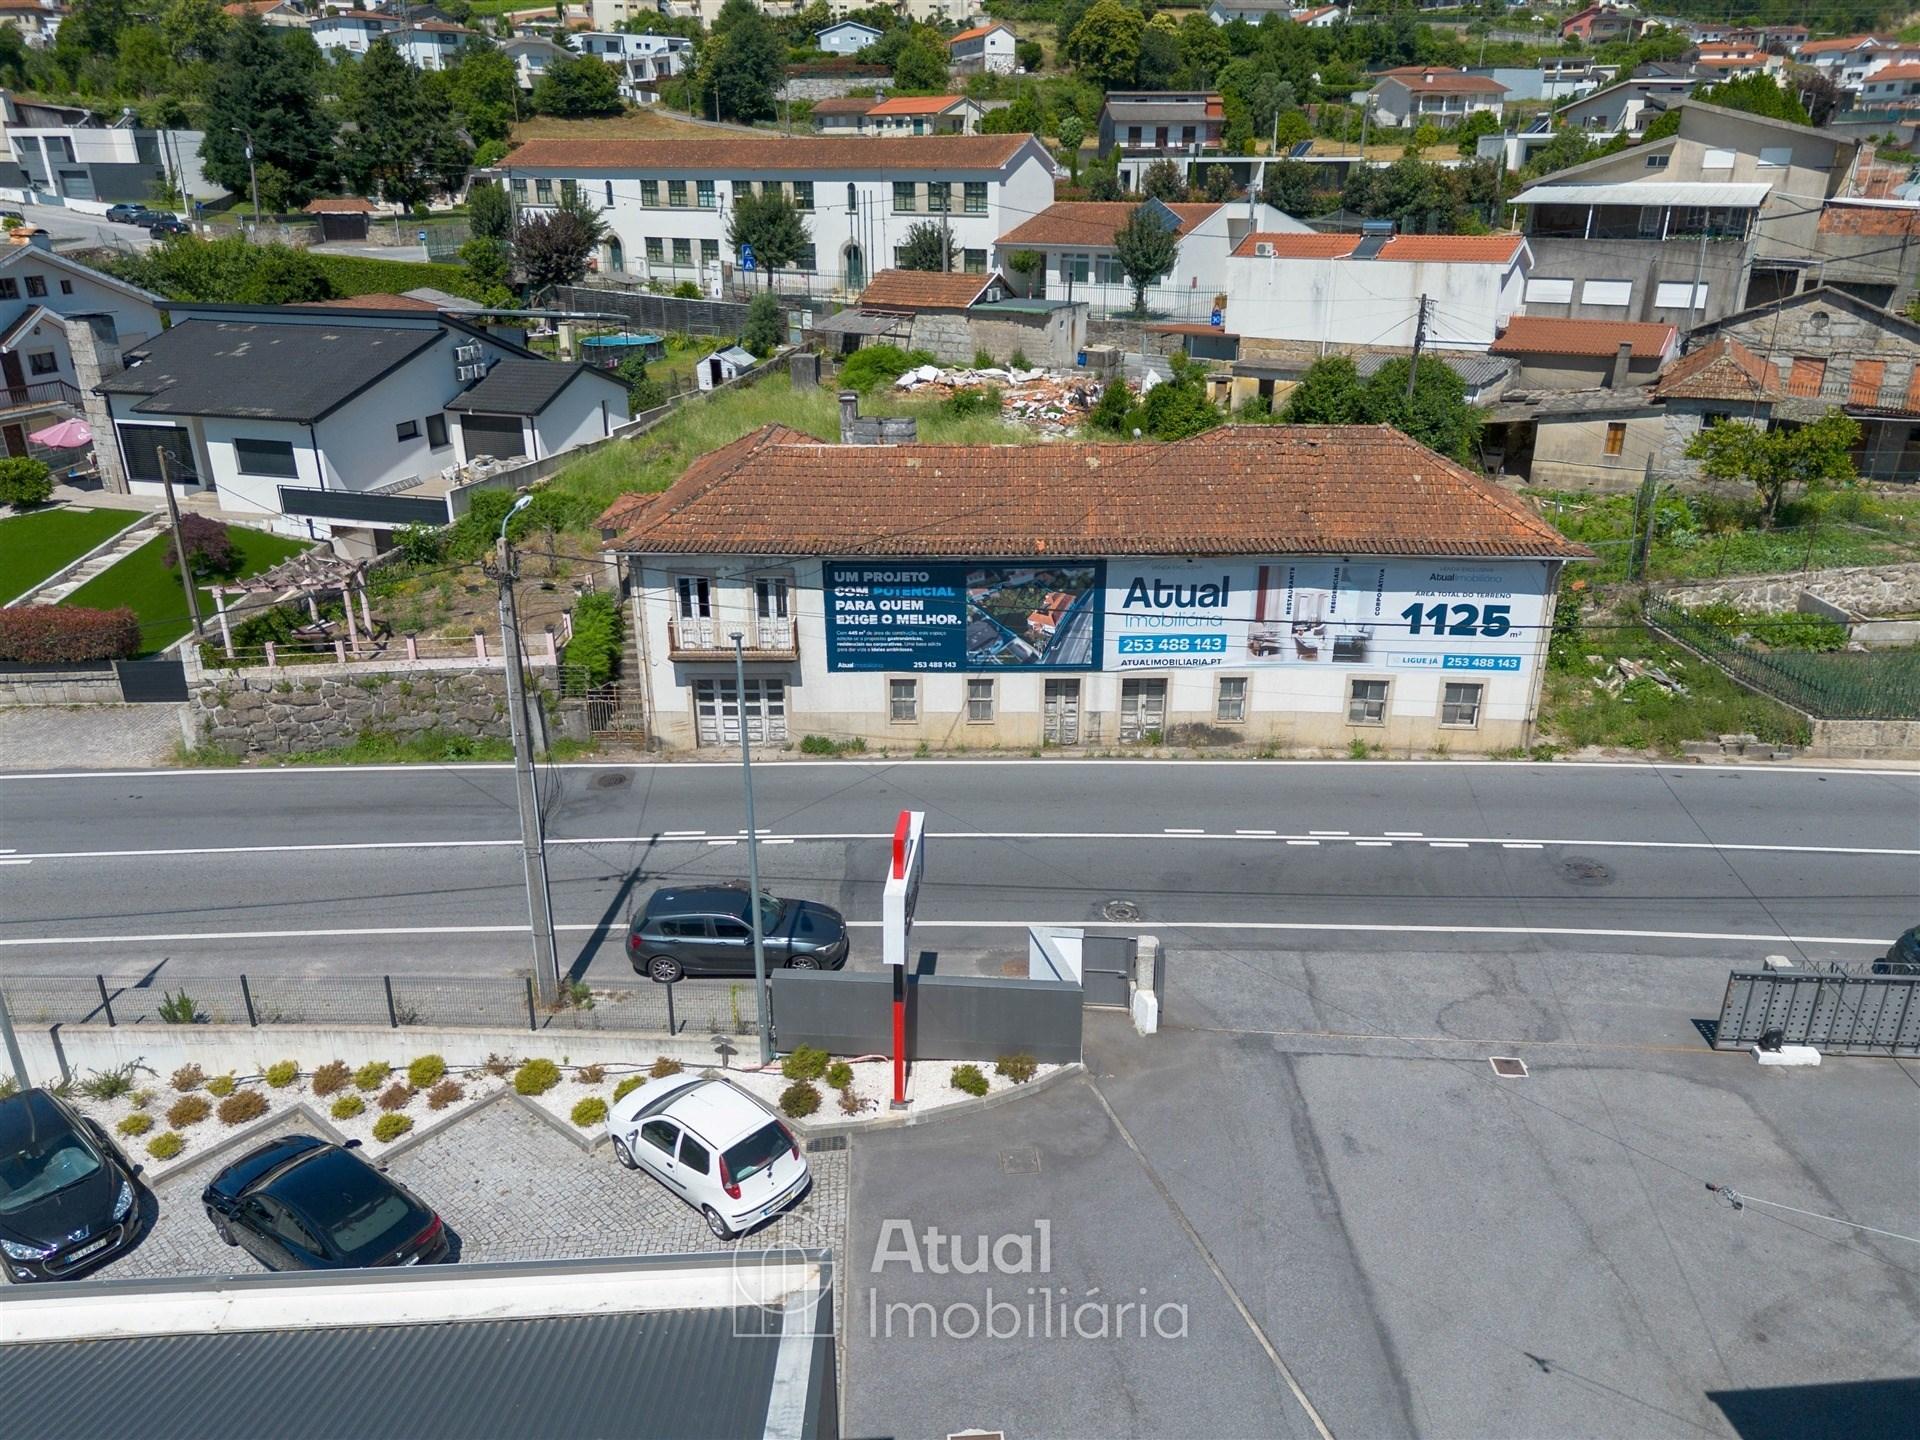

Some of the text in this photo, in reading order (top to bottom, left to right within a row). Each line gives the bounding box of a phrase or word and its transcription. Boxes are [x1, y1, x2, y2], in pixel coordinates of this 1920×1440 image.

[834, 571, 930, 583] UM PROJETO
[834, 586, 956, 597] COM POTENCIAL
[1122, 576, 1230, 609] Atual
[835, 600, 924, 611] PARA QUEM
[836, 614, 962, 625] EXIGE O MELHOR.
[1401, 602, 1511, 637] 1125
[1123, 638, 1221, 652] 253 488 143
[1121, 658, 1222, 667] ATUALIMOBILIARIA.PT
[1447, 657, 1517, 668] 253 488 143
